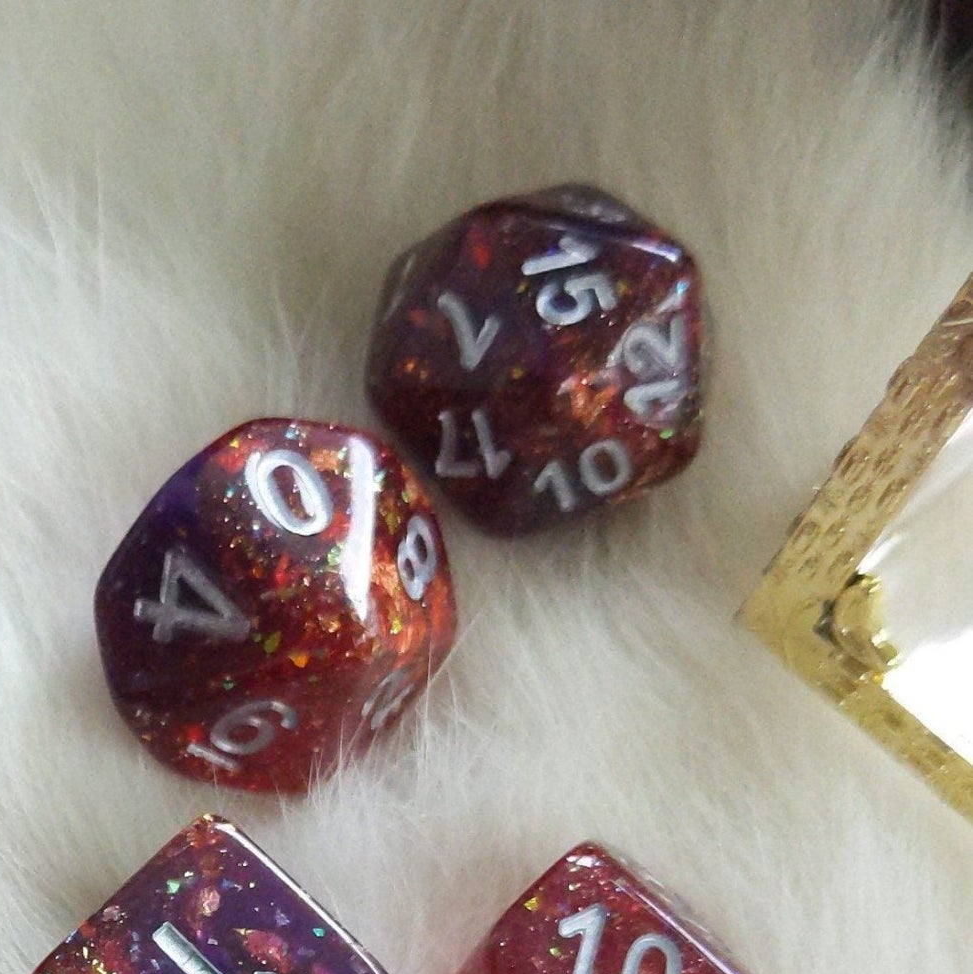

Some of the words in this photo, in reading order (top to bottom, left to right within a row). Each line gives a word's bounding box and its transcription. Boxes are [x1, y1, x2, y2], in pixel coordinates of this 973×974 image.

[521, 234, 619, 326] 15
[244, 449, 332, 536] 0
[533, 438, 632, 513] 10
[133, 547, 251, 644] 4
[397, 515, 437, 601] 8
